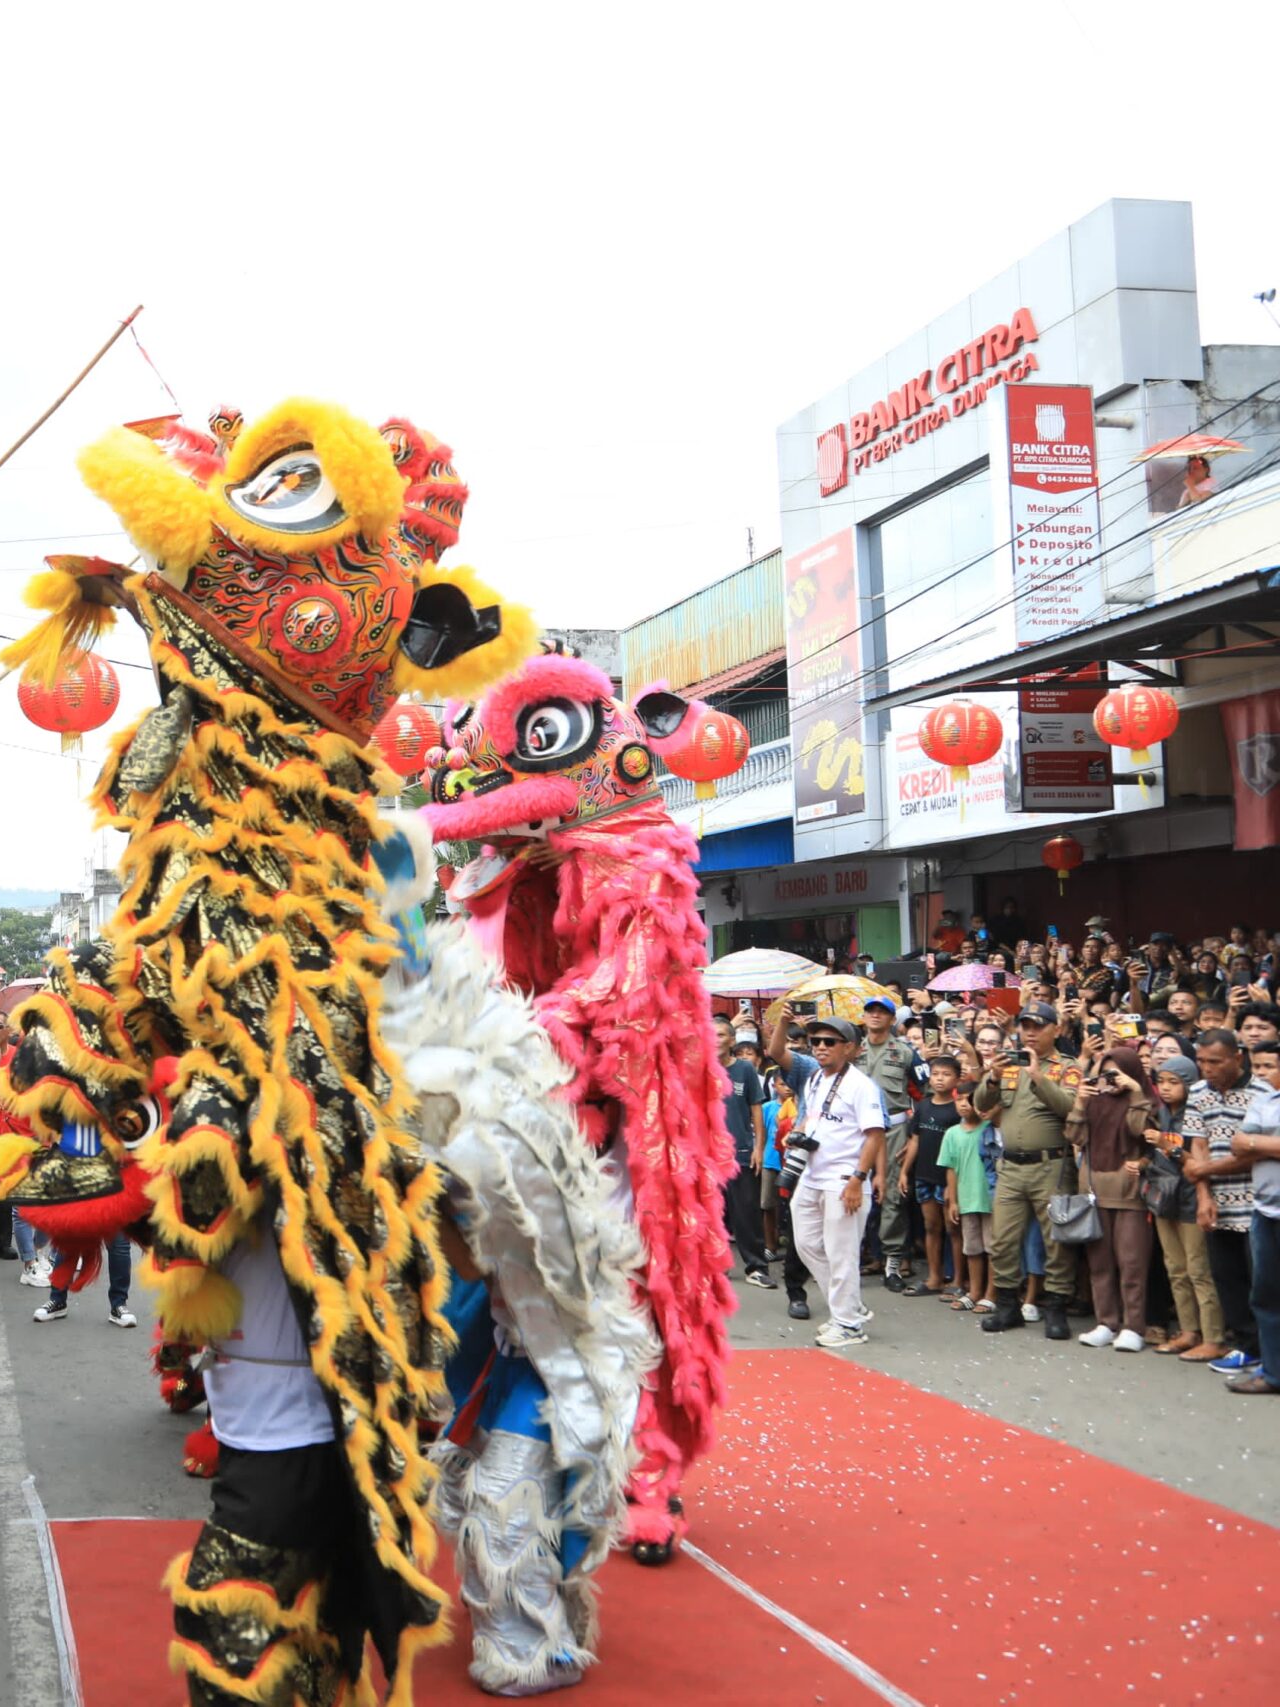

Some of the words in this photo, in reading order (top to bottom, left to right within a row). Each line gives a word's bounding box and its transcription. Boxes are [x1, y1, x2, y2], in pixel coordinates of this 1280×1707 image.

[850, 370, 934, 450] BANK
[936, 308, 1039, 394] CITRA
[853, 450, 872, 475] PT
[871, 432, 902, 463] BPR
[902, 405, 951, 444] CITRA
[1012, 443, 1049, 455] BANK
[1052, 444, 1091, 456] CITRA
[1059, 456, 1091, 464] DUMOGA
[1026, 503, 1083, 515] Melayani:
[1028, 523, 1092, 536] Tabungan
[1029, 539, 1093, 551] Deposito
[1030, 555, 1093, 566] Kredit
[1031, 607, 1059, 615] Kredit
[899, 767, 955, 801] KREDIT
[900, 801, 921, 816] CEPAT
[930, 795, 958, 811] MUDAH
[775, 874, 828, 900] KEMBANG
[835, 870, 868, 894] BARU
